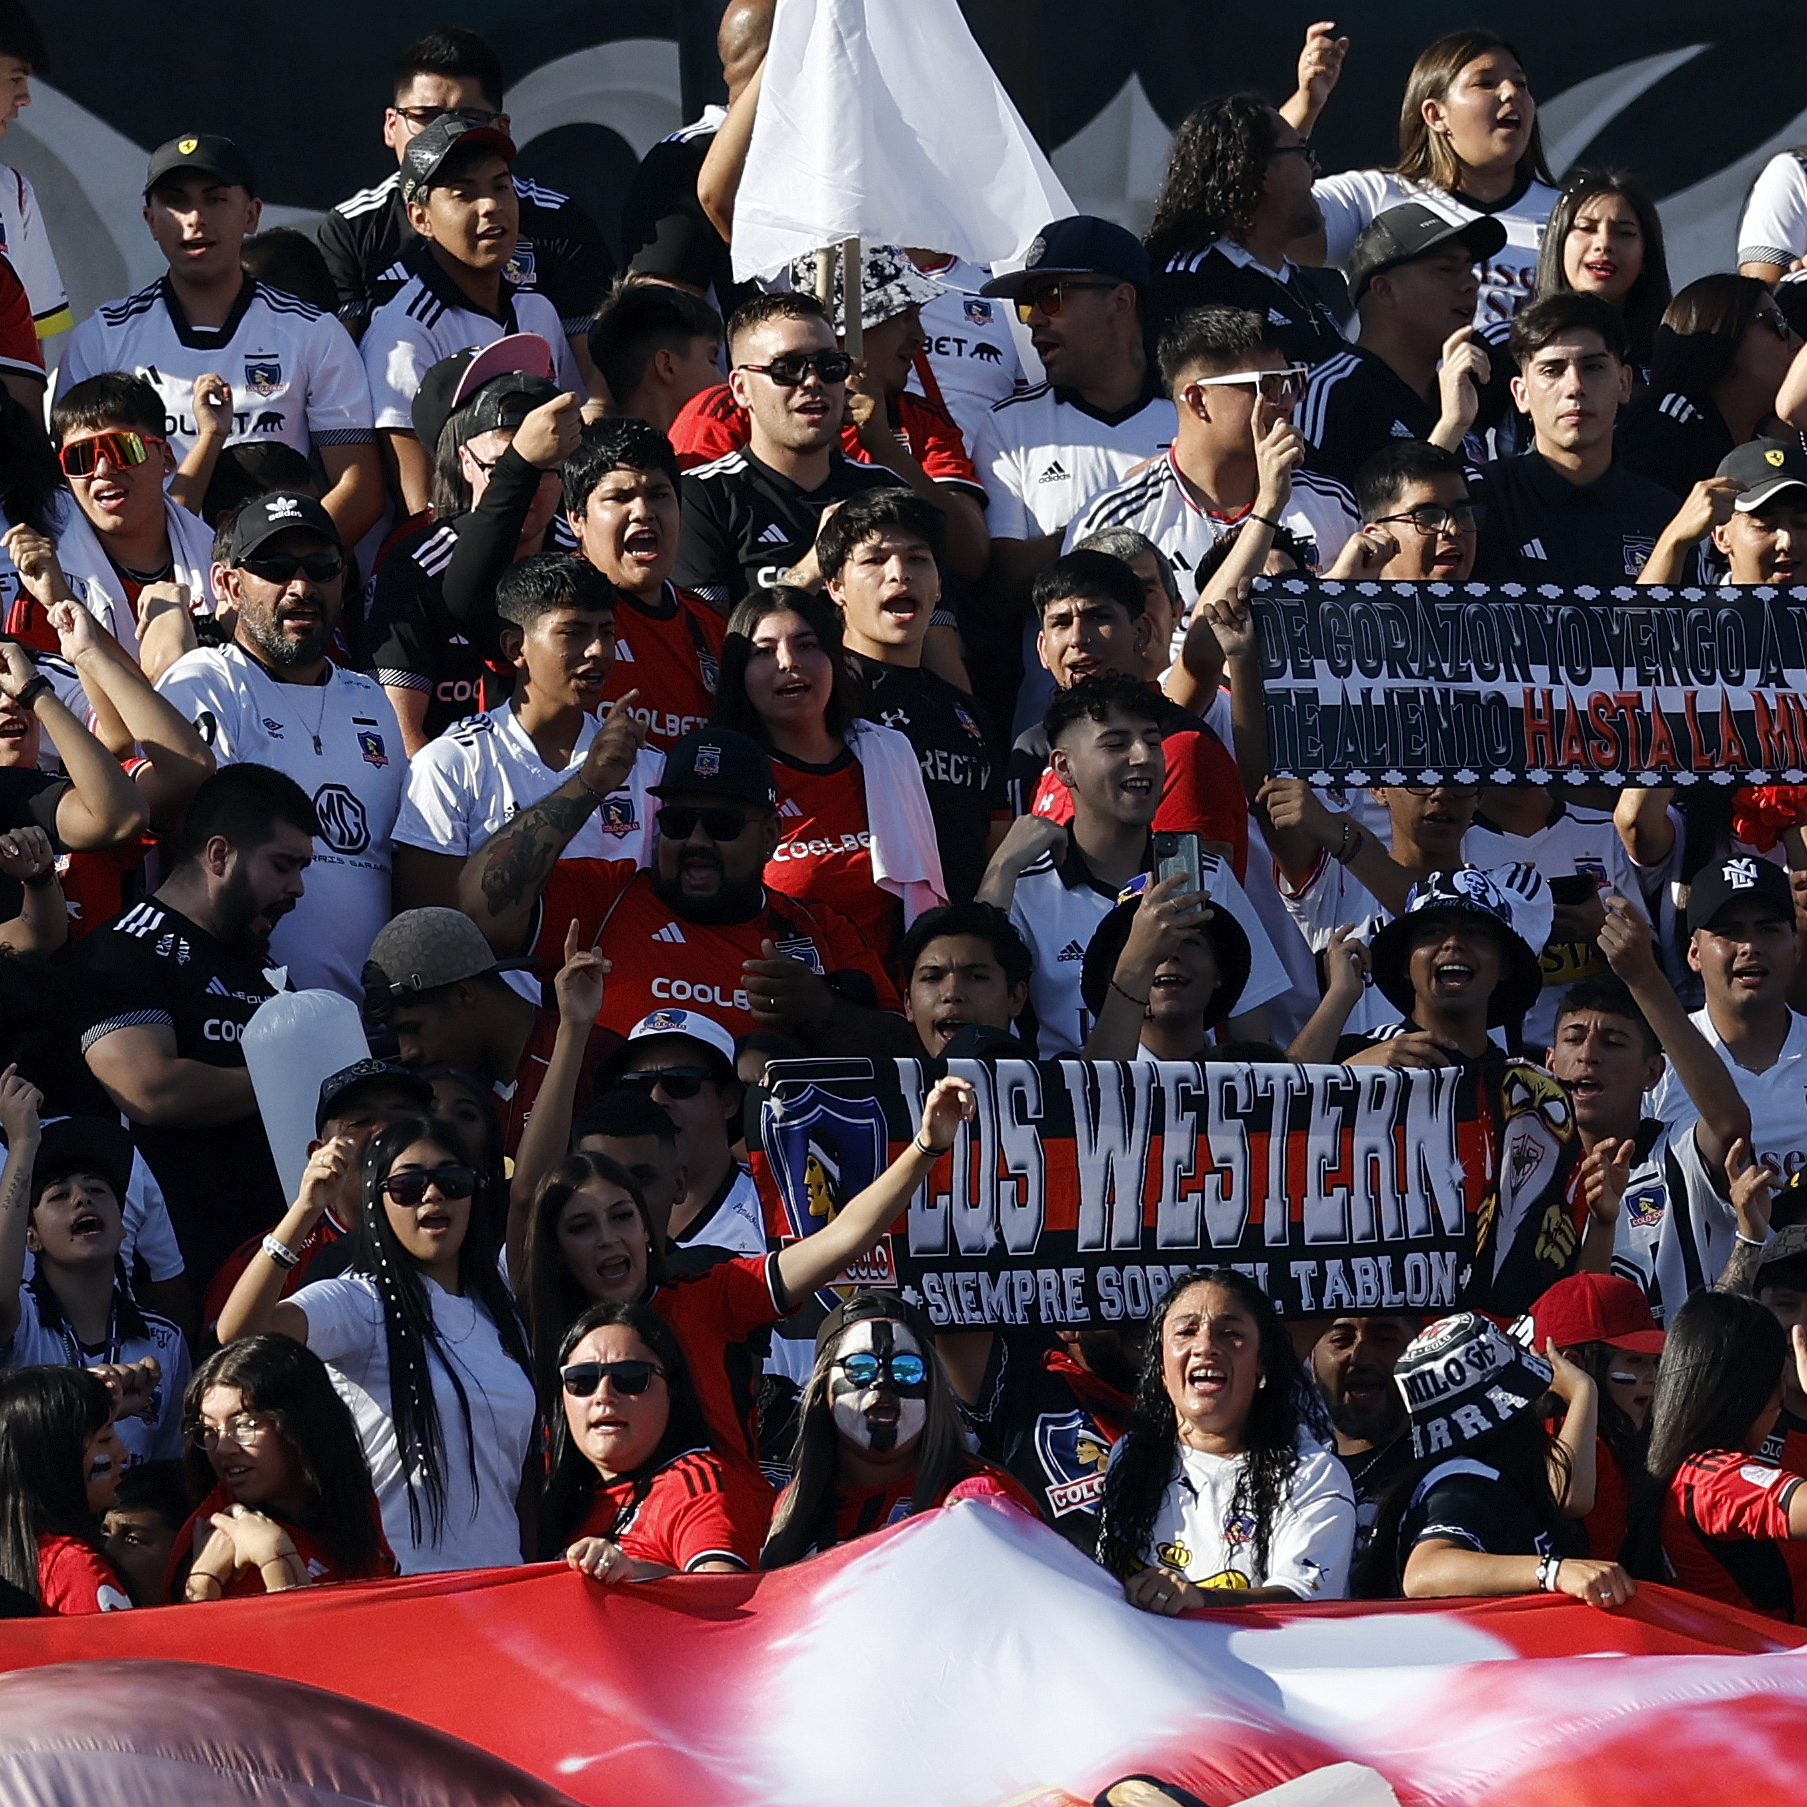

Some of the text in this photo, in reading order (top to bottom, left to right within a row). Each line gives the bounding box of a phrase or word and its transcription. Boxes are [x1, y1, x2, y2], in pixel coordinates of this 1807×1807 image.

[267, 510, 304, 522] adidas
[1038, 472, 1072, 485] adidas
[1251, 598, 1317, 680] DE
[1526, 602, 1593, 686] YO
[1590, 605, 1746, 692] VENGO
[1757, 600, 1794, 689] A
[1266, 686, 1325, 770] TE
[1522, 680, 1680, 772] HASTA
[1683, 686, 1755, 772] LA
[1721, 858, 1759, 890] NY
[893, 1057, 1465, 1258] LOS WESTERN
[921, 1251, 1457, 1326] SIEMPRE TABLON
